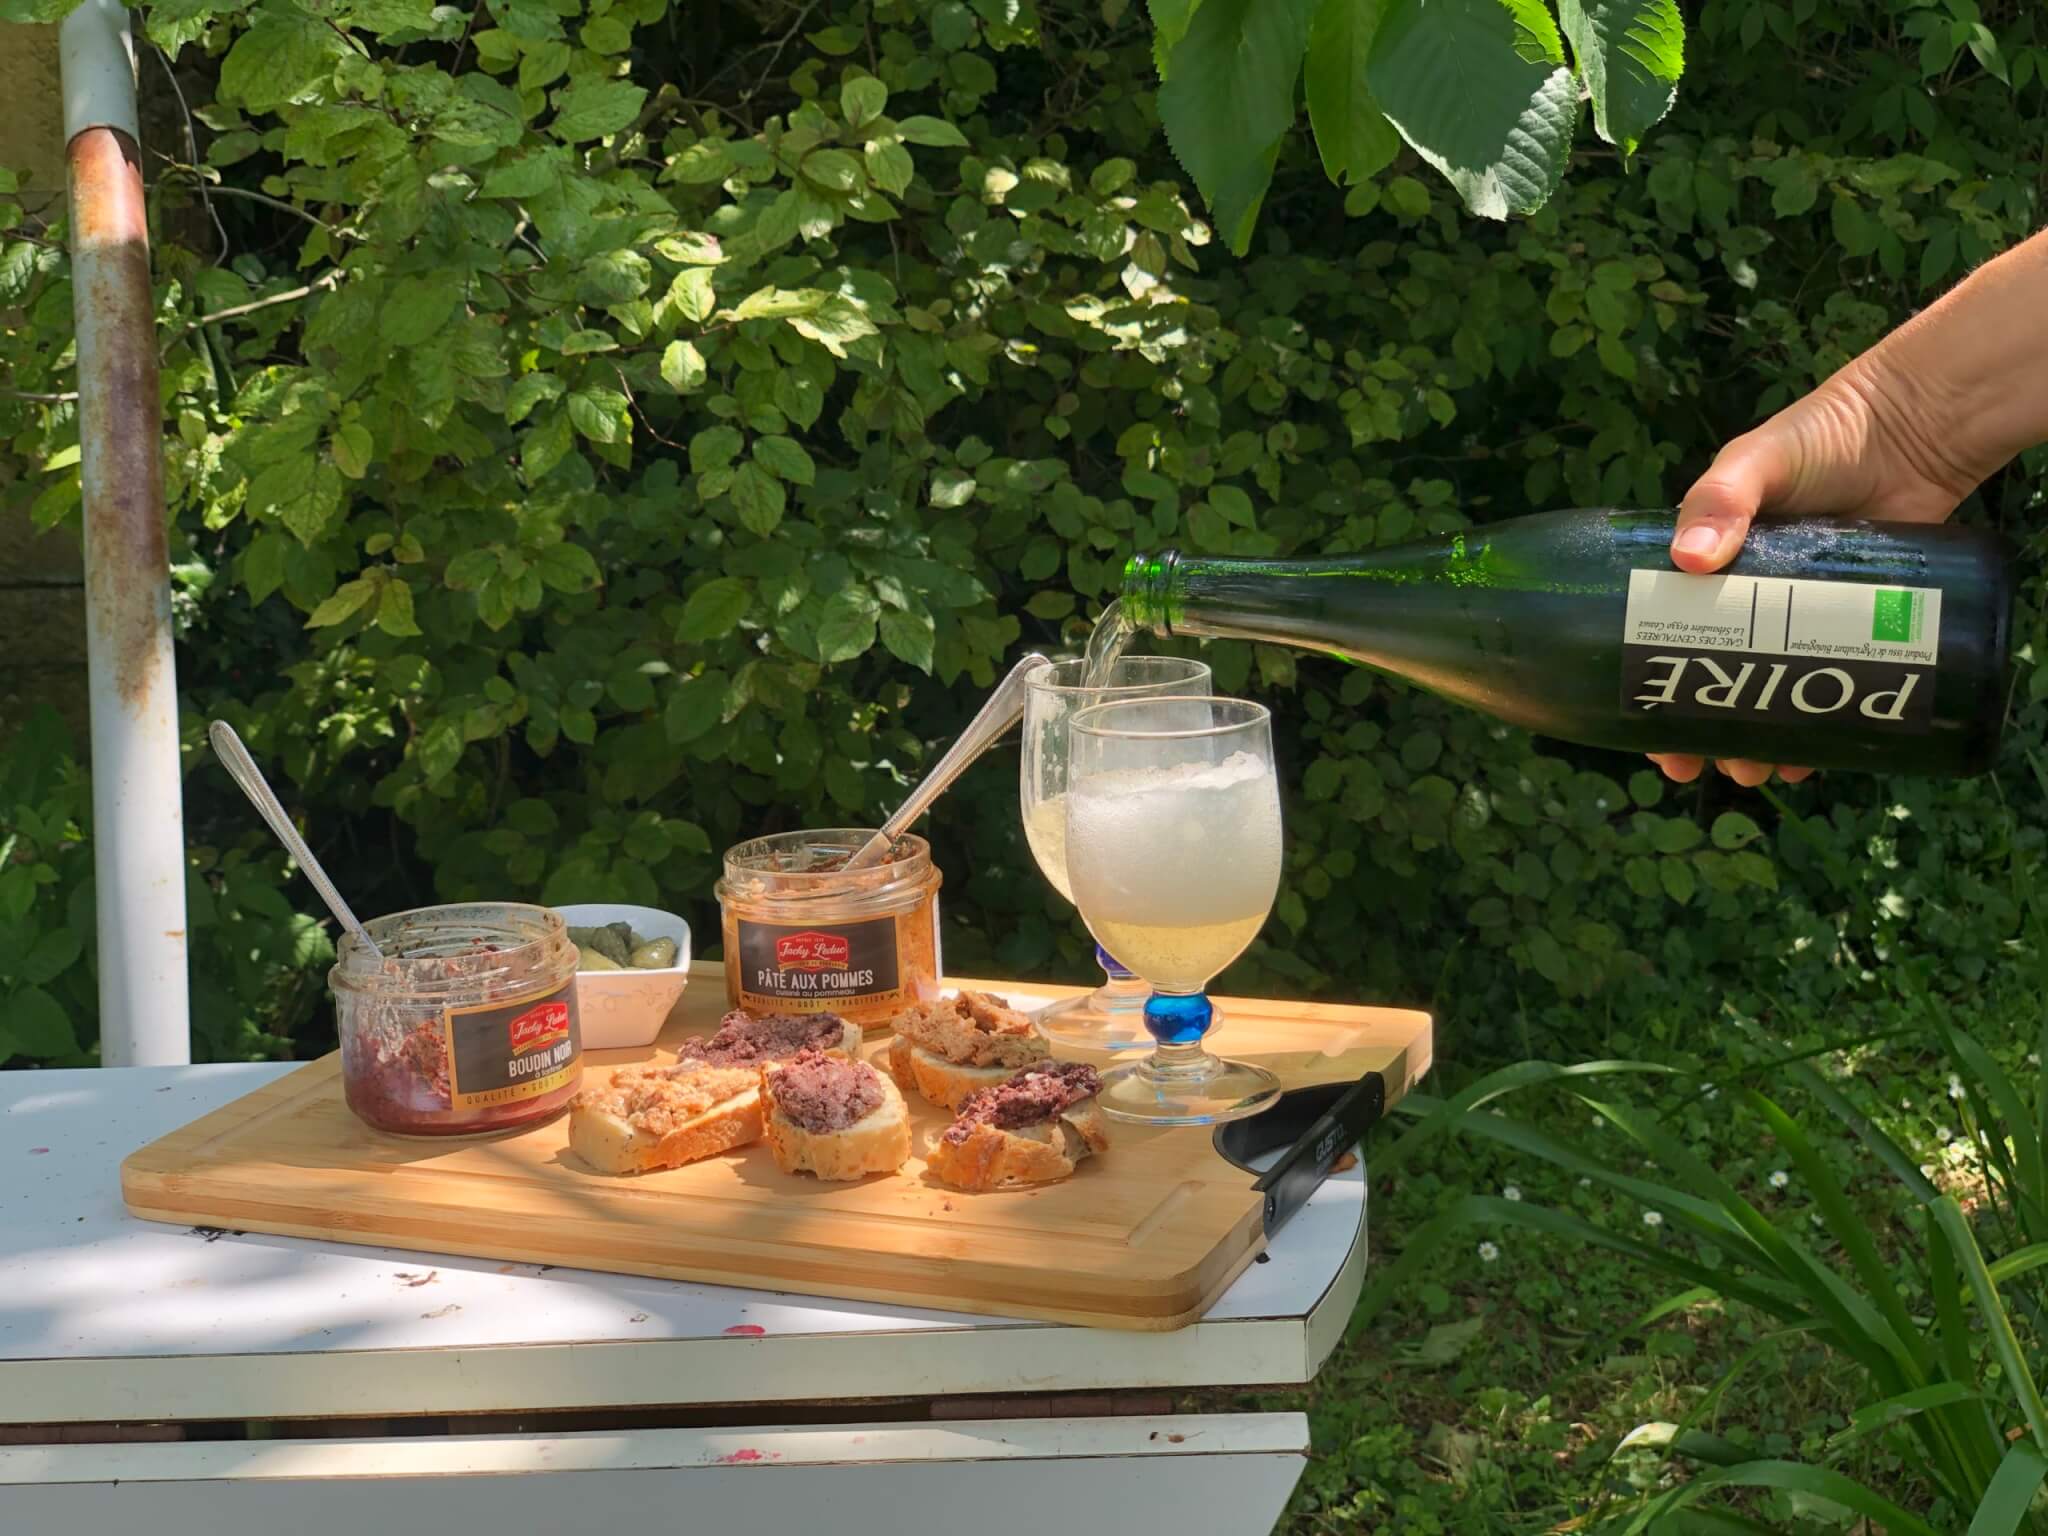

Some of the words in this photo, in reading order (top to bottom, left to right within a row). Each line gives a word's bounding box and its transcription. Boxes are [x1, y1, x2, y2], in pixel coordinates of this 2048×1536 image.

[1734, 628, 1744, 636] La
[1699, 636, 1716, 645] DES
[1720, 638, 1743, 647] GAEC
[1878, 648, 1886, 658] de
[1888, 649, 1903, 659] issu
[1905, 650, 1932, 661] Produit
[1633, 655, 1921, 720] POIRÉ
[779, 942, 809, 958] Jacky
[811, 943, 846, 960] Leduc
[791, 974, 817, 989] AUX
[822, 970, 873, 989] POMMES
[814, 989, 855, 998] pommeau
[509, 1050, 551, 1077] BOUDIN
[554, 1040, 572, 1066] NOIR
